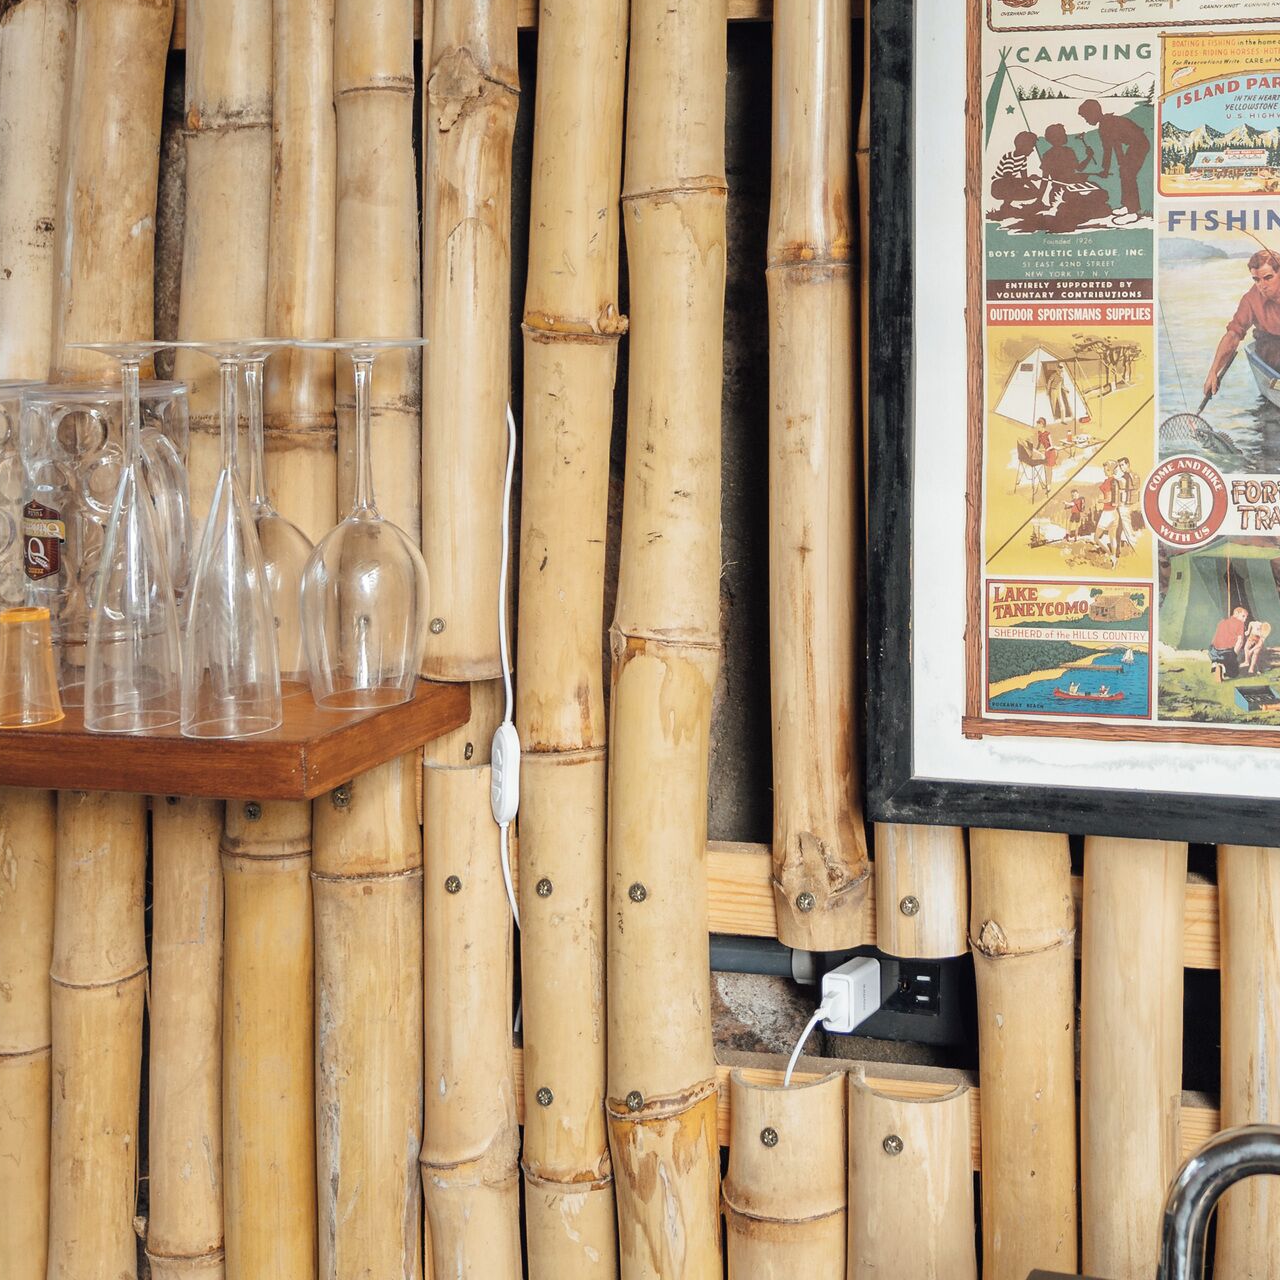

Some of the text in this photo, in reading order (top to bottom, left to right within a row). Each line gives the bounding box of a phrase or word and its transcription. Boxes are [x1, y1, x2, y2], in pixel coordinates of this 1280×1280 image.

[1172, 39, 1200, 47] BOATING
[1207, 38, 1236, 46] FISHING
[1016, 43, 1152, 63] CAMPING
[1172, 49, 1198, 57] GUIDES
[1202, 48, 1227, 56] RIDING
[1230, 47, 1259, 55] HORSES
[1176, 79, 1240, 109] ISLAND
[1224, 103, 1278, 111] YELLOWSTONE
[1056, 281, 1113, 289] SUPPORTED
[996, 291, 1055, 299] VOLUNTARY
[990, 307, 1151, 320] OUTDOOR SPORTSMANS SUPPLIES
[1148, 460, 1223, 492] COME AND HIKE
[1159, 524, 1210, 542] WITH US
[993, 586, 1038, 604] LAKE
[993, 600, 1089, 620] TANEYCOMO
[994, 628, 1042, 638] SHEPHERD
[1057, 630, 1070, 638] the
[1072, 632, 1099, 640] HILLS
[1102, 632, 1145, 641] COUNTRY
